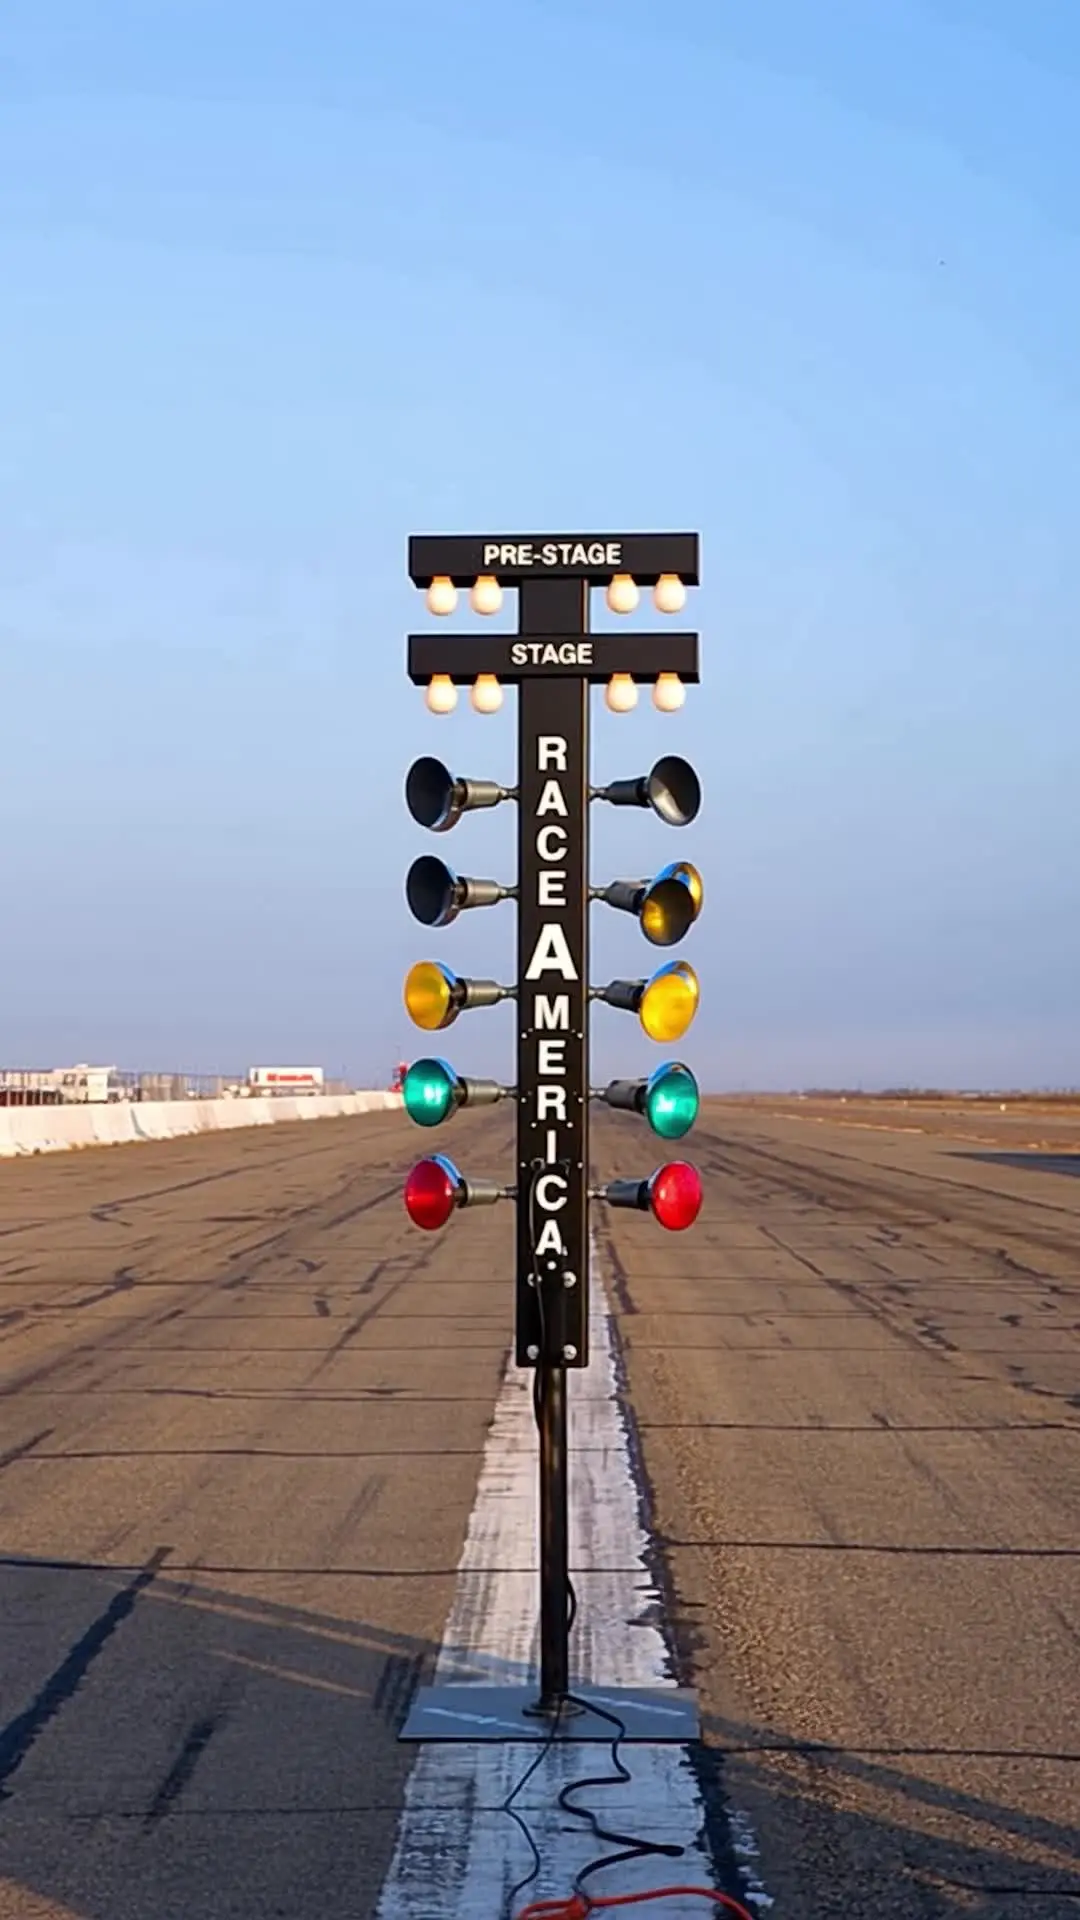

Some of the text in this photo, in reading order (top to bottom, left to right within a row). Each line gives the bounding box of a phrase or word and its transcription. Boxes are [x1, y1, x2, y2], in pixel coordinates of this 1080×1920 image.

[483, 543, 622, 566] PRE-STAGE
[511, 643, 593, 665] STAGE
[525, 735, 579, 1256] RACE AMERICA
